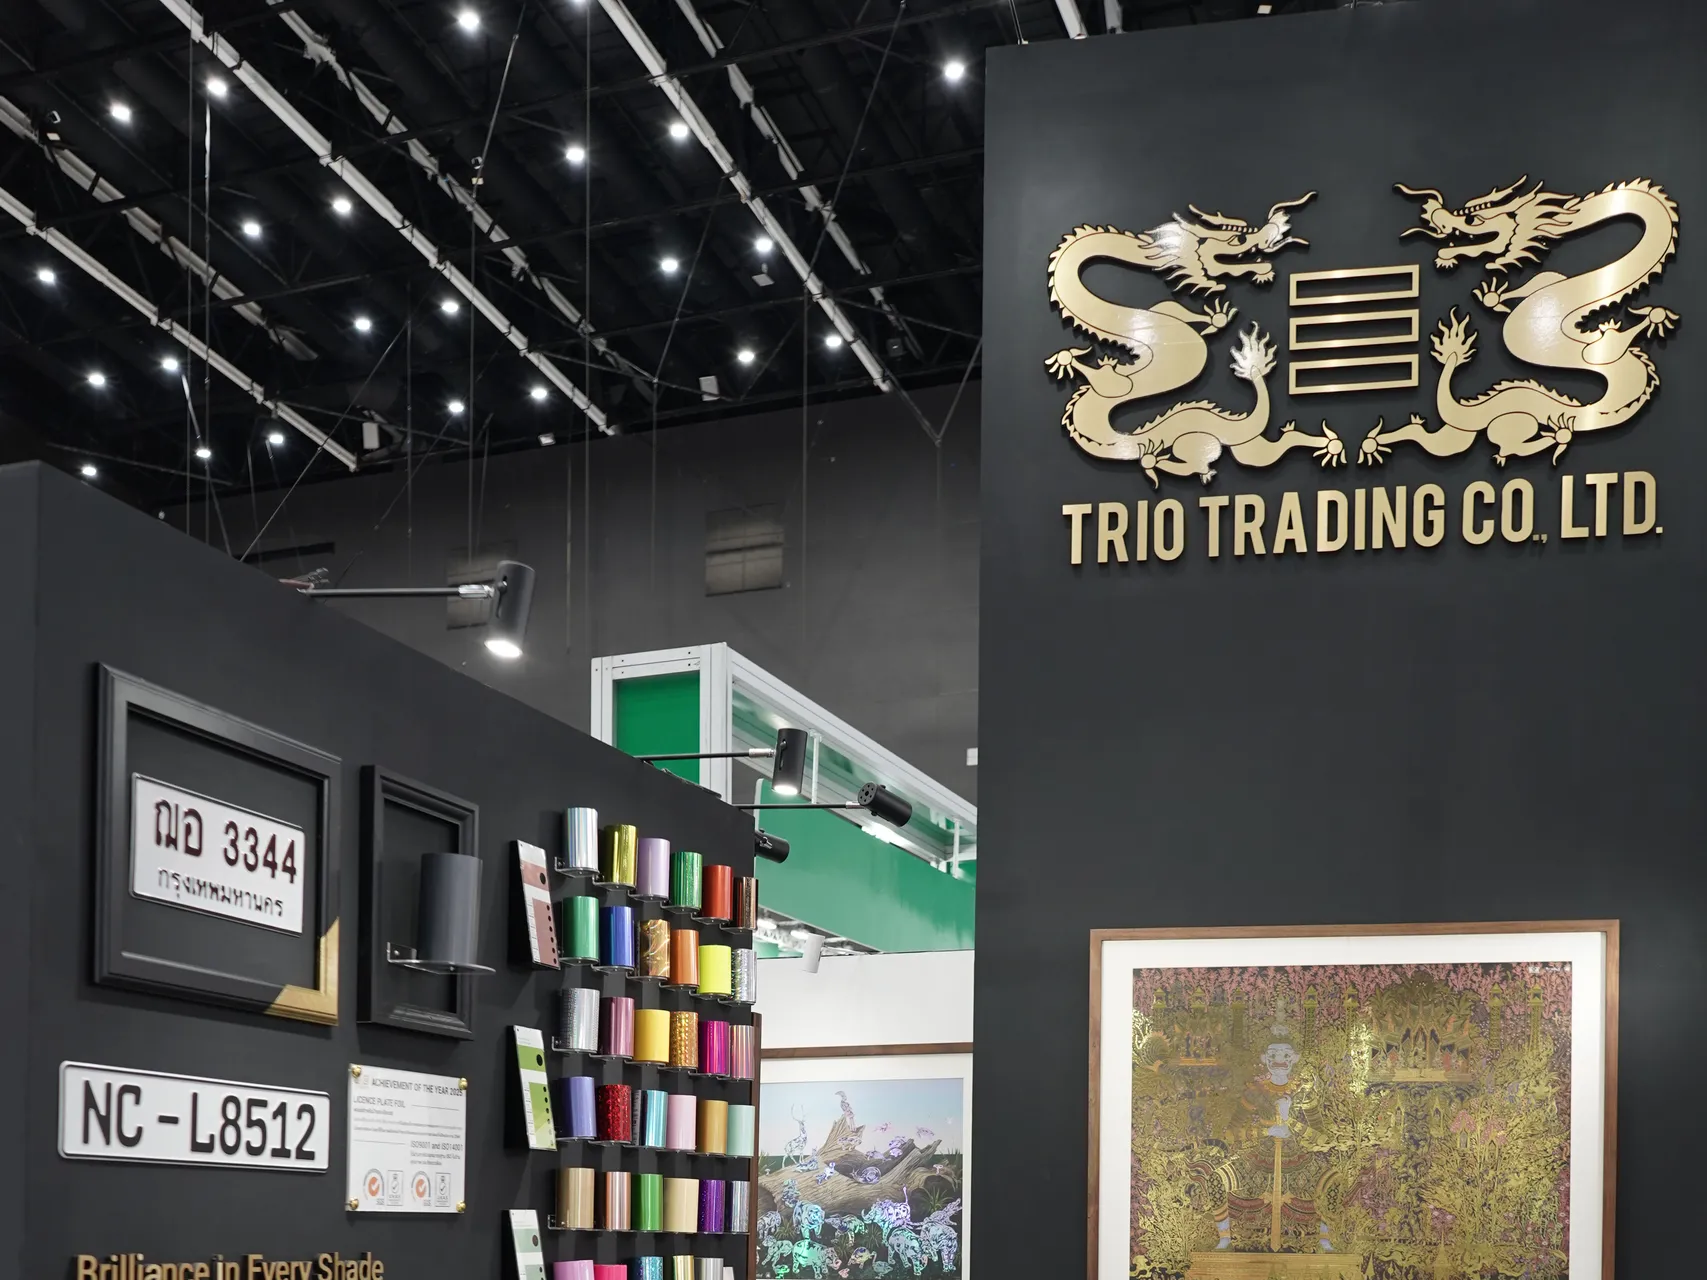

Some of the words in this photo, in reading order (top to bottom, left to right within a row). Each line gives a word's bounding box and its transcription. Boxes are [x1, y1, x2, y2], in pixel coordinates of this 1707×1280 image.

[1062, 498, 1185, 565] TRIO
[1199, 483, 1446, 558] TRADING
[1462, 478, 1548, 545] CO.,
[1560, 470, 1663, 538] LTD.
[223, 819, 297, 885] 3344
[158, 868, 284, 917] กรุงเทพมหานคร
[353, 1095, 376, 1105] LICENCE
[377, 1098, 394, 1107] PLATE
[394, 1100, 406, 1108] FOIL
[372, 1078, 413, 1091] ACHIEVEMENT
[414, 1083, 422, 1093] OF
[423, 1085, 434, 1094] THE
[434, 1086, 449, 1096] YEAR
[449, 1088, 463, 1097] 2025
